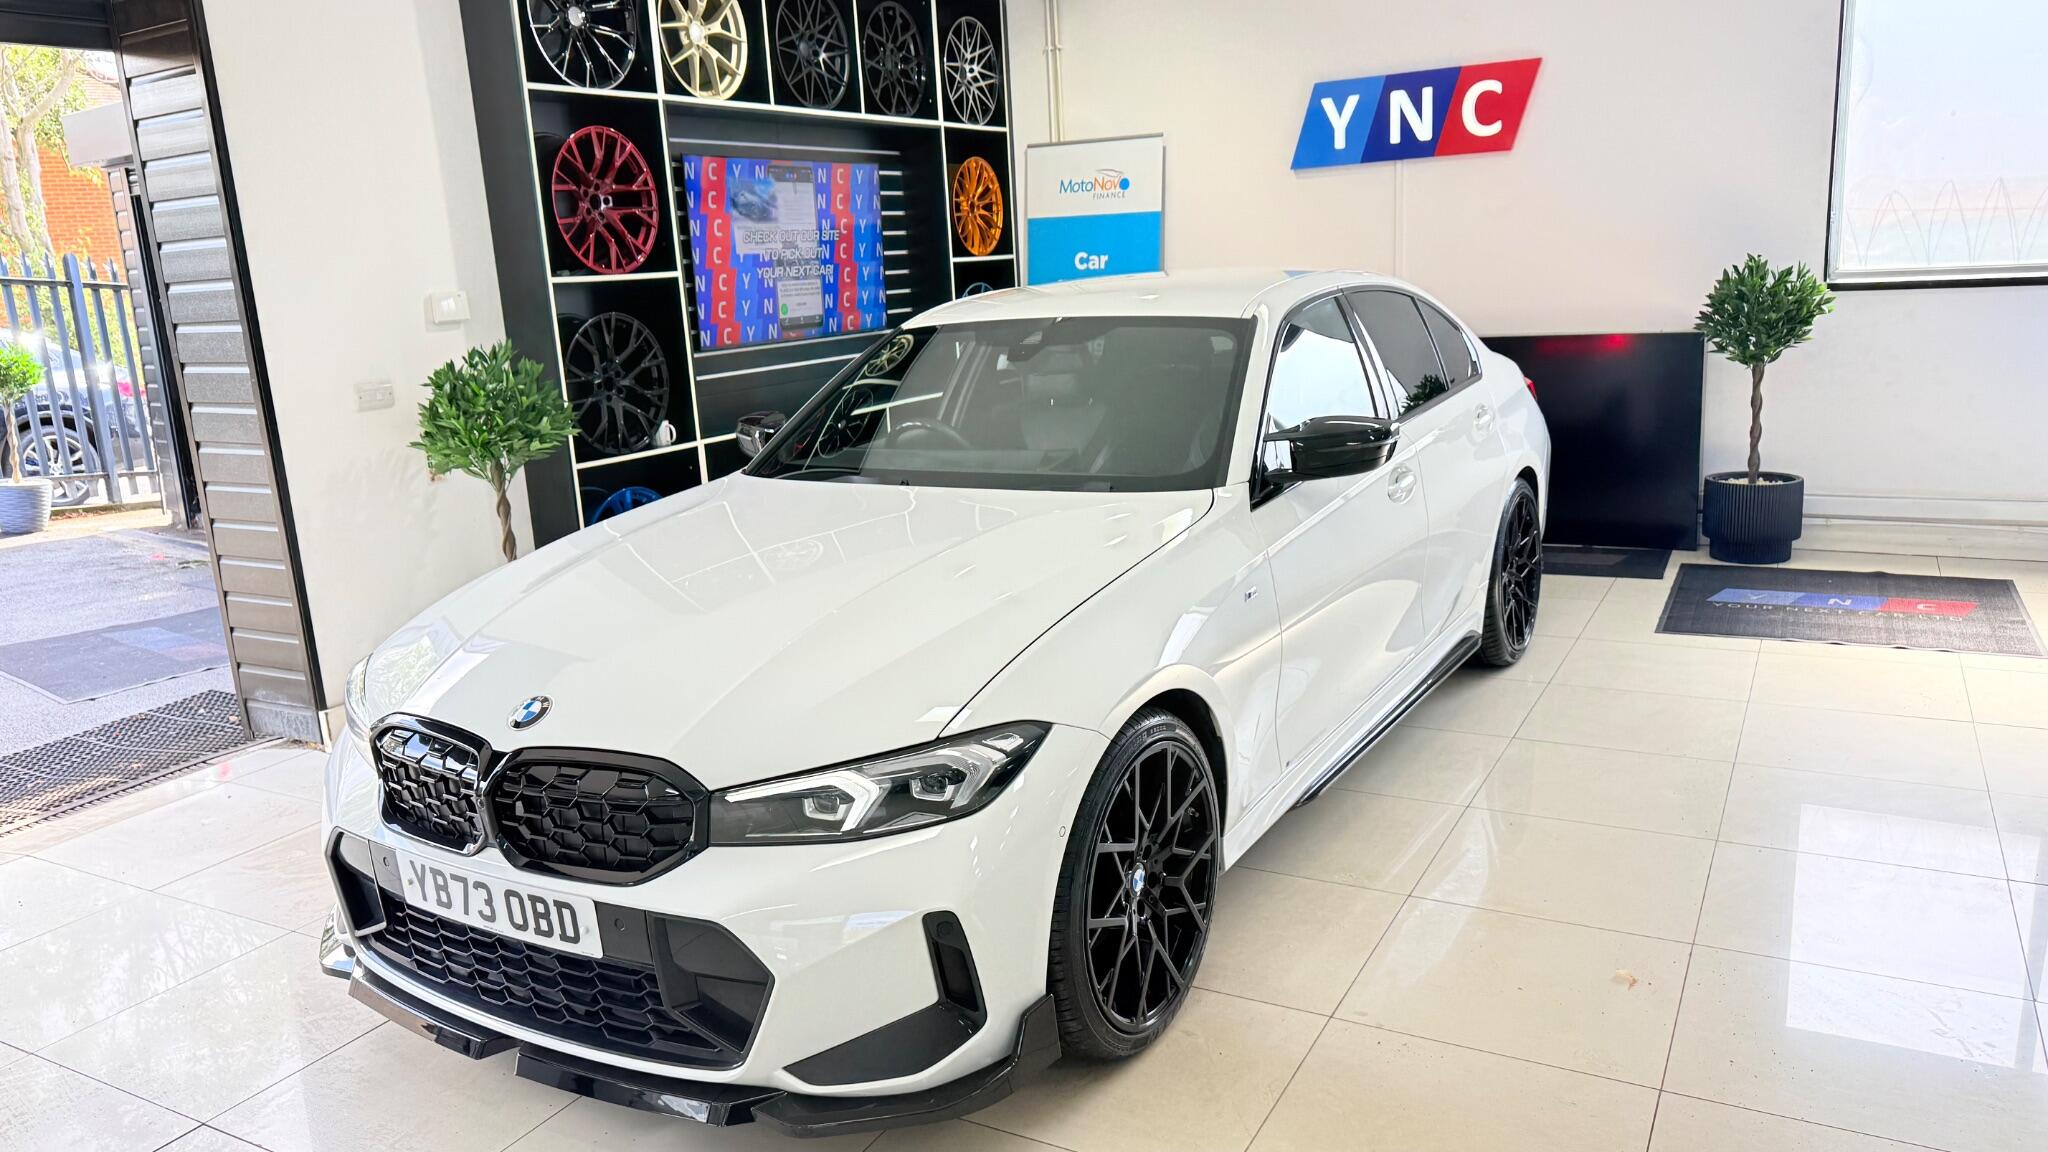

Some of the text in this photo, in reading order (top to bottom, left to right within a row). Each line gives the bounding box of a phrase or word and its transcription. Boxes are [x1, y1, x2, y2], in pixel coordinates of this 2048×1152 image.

[1320, 79, 1503, 150] YNC
[1059, 176, 1130, 194] MotoNovo
[1093, 191, 1126, 200] FINANCE
[743, 232, 777, 243] CHECK
[780, 231, 799, 242] OUT
[821, 230, 840, 241] SITE
[767, 248, 779, 260] TO
[781, 248, 801, 259] PICK
[804, 247, 822, 259] OUT
[1074, 251, 1109, 270] Car
[757, 267, 783, 278] YOUR
[786, 266, 809, 277] NEXT
[1712, 602, 1773, 610] YOUR
[1786, 606, 1846, 614] NEXT
[409, 859, 581, 945] YB73 OBD
